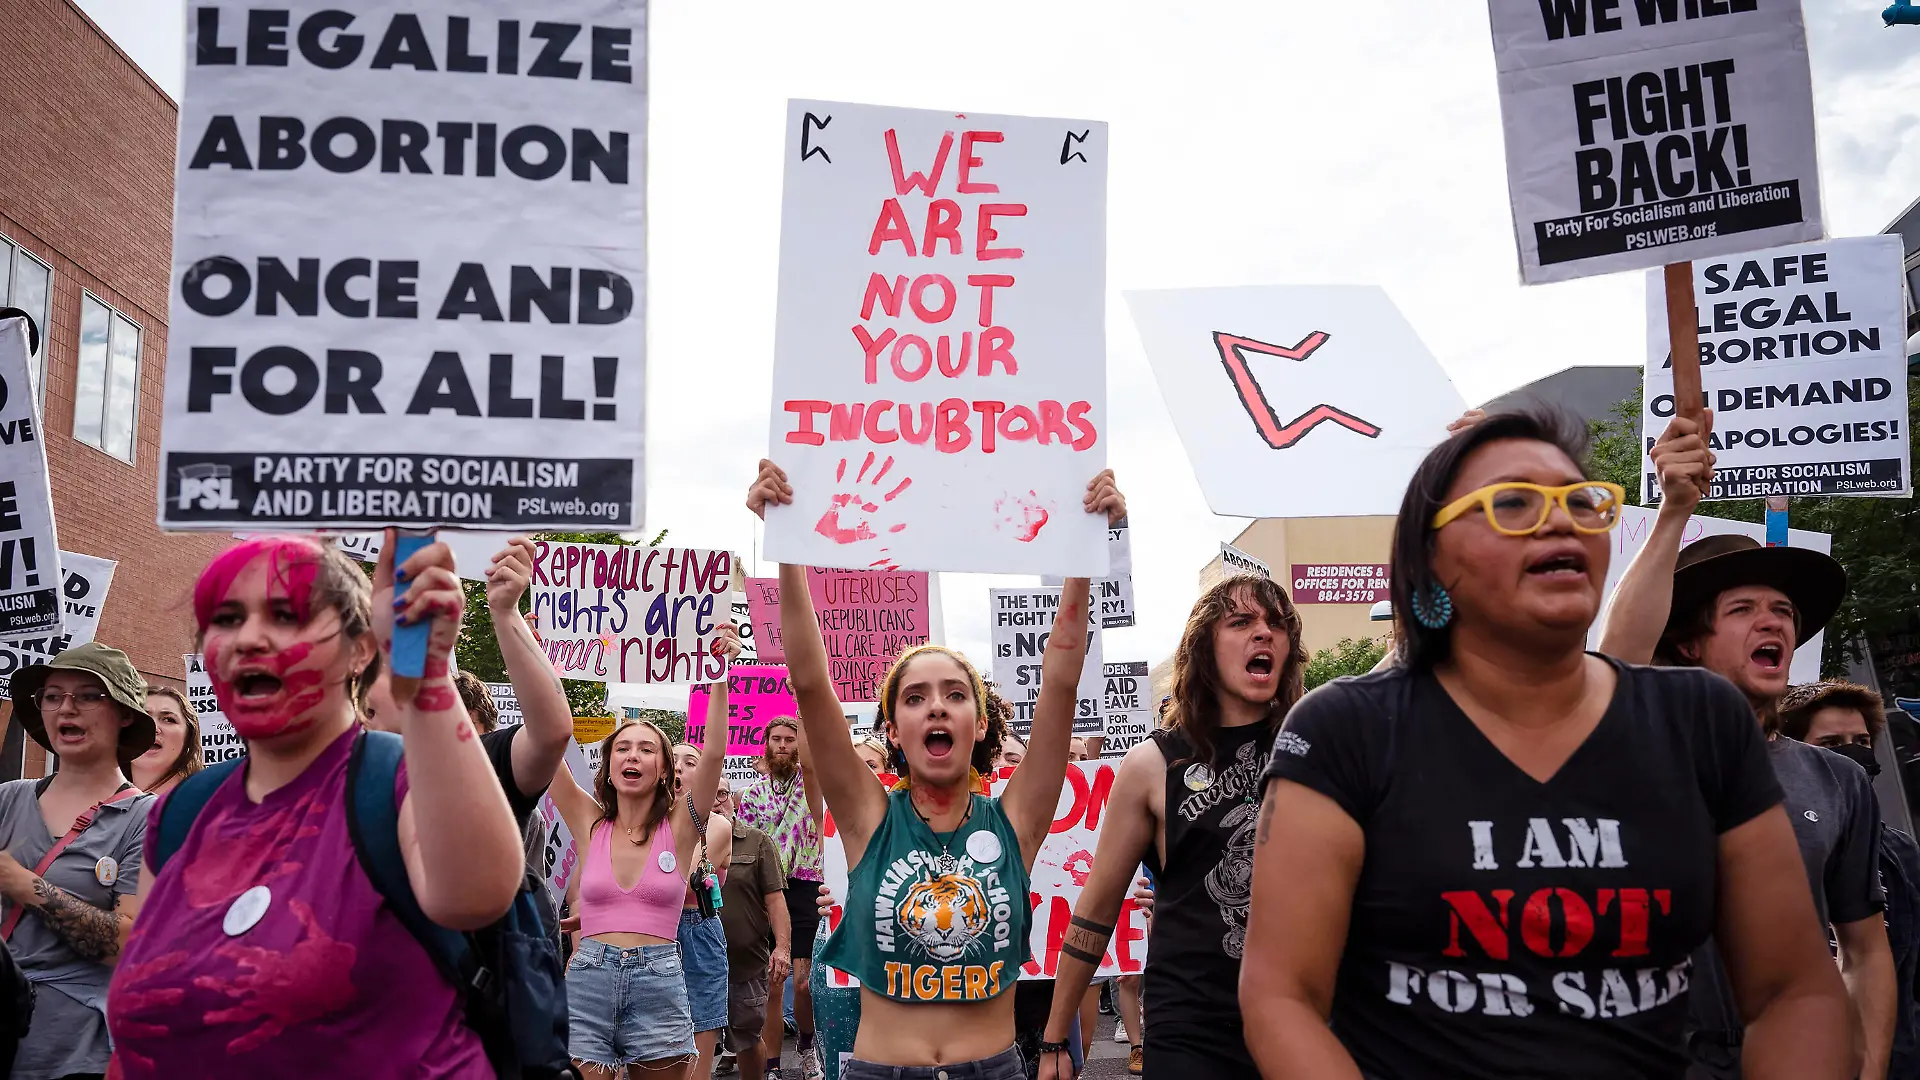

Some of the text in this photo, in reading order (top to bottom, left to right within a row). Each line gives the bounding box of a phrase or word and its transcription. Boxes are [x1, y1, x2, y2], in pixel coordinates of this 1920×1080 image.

[196, 8, 633, 84] LEGALIZE
[1573, 58, 1735, 146] FIGHT
[188, 115, 630, 184] ABORTION
[884, 128, 1005, 197] WE
[1575, 123, 1752, 213] BACK!
[868, 198, 1028, 261] ARE
[1545, 185, 1790, 238] Party For Socialism and Liberation
[1626, 221, 1717, 249] PSLWEB.org
[181, 255, 634, 326] ONCE AND
[1704, 253, 1829, 295] SAFE
[859, 272, 1015, 327] NOT
[852, 324, 1019, 384] YOUR
[1662, 327, 1880, 369] BORTION
[187, 346, 618, 422] FOR ALL!
[1650, 377, 1892, 418] O DEMAND
[784, 397, 1098, 453] INCUBTORS
[253, 456, 579, 488] PARTY FOR SOCIALISM
[1709, 462, 1871, 482] RTY FOR SOCIALISM
[1727, 480, 1823, 496] LIBERATION
[1836, 478, 1897, 491] PSLweb.org
[178, 477, 239, 511] PSL
[252, 490, 620, 520] AND LIBERATION PSLweb.org
[1223, 549, 1270, 578] ABORTION
[1295, 579, 1339, 589] OFFICES
[1342, 579, 1364, 589] FOR
[1307, 567, 1383, 577] RESIDENCES &
[824, 575, 918, 605] UTERUSES
[998, 594, 1062, 609] THE TIM
[1318, 591, 1375, 601] 884-3578
[535, 589, 628, 635] rights
[645, 592, 715, 638] are
[823, 608, 915, 632] REPUBLICANS
[998, 612, 1046, 627] FIGHT
[620, 637, 726, 683] rights
[845, 634, 877, 658] CARE
[997, 644, 1011, 658] IS
[833, 661, 876, 680] DYING
[1109, 715, 1128, 724] FOR
[1468, 818, 1628, 870] I AM
[1441, 887, 1671, 960] NOT
[884, 960, 1005, 1001] TIGERS
[1385, 955, 1692, 1020] FOR SALE
